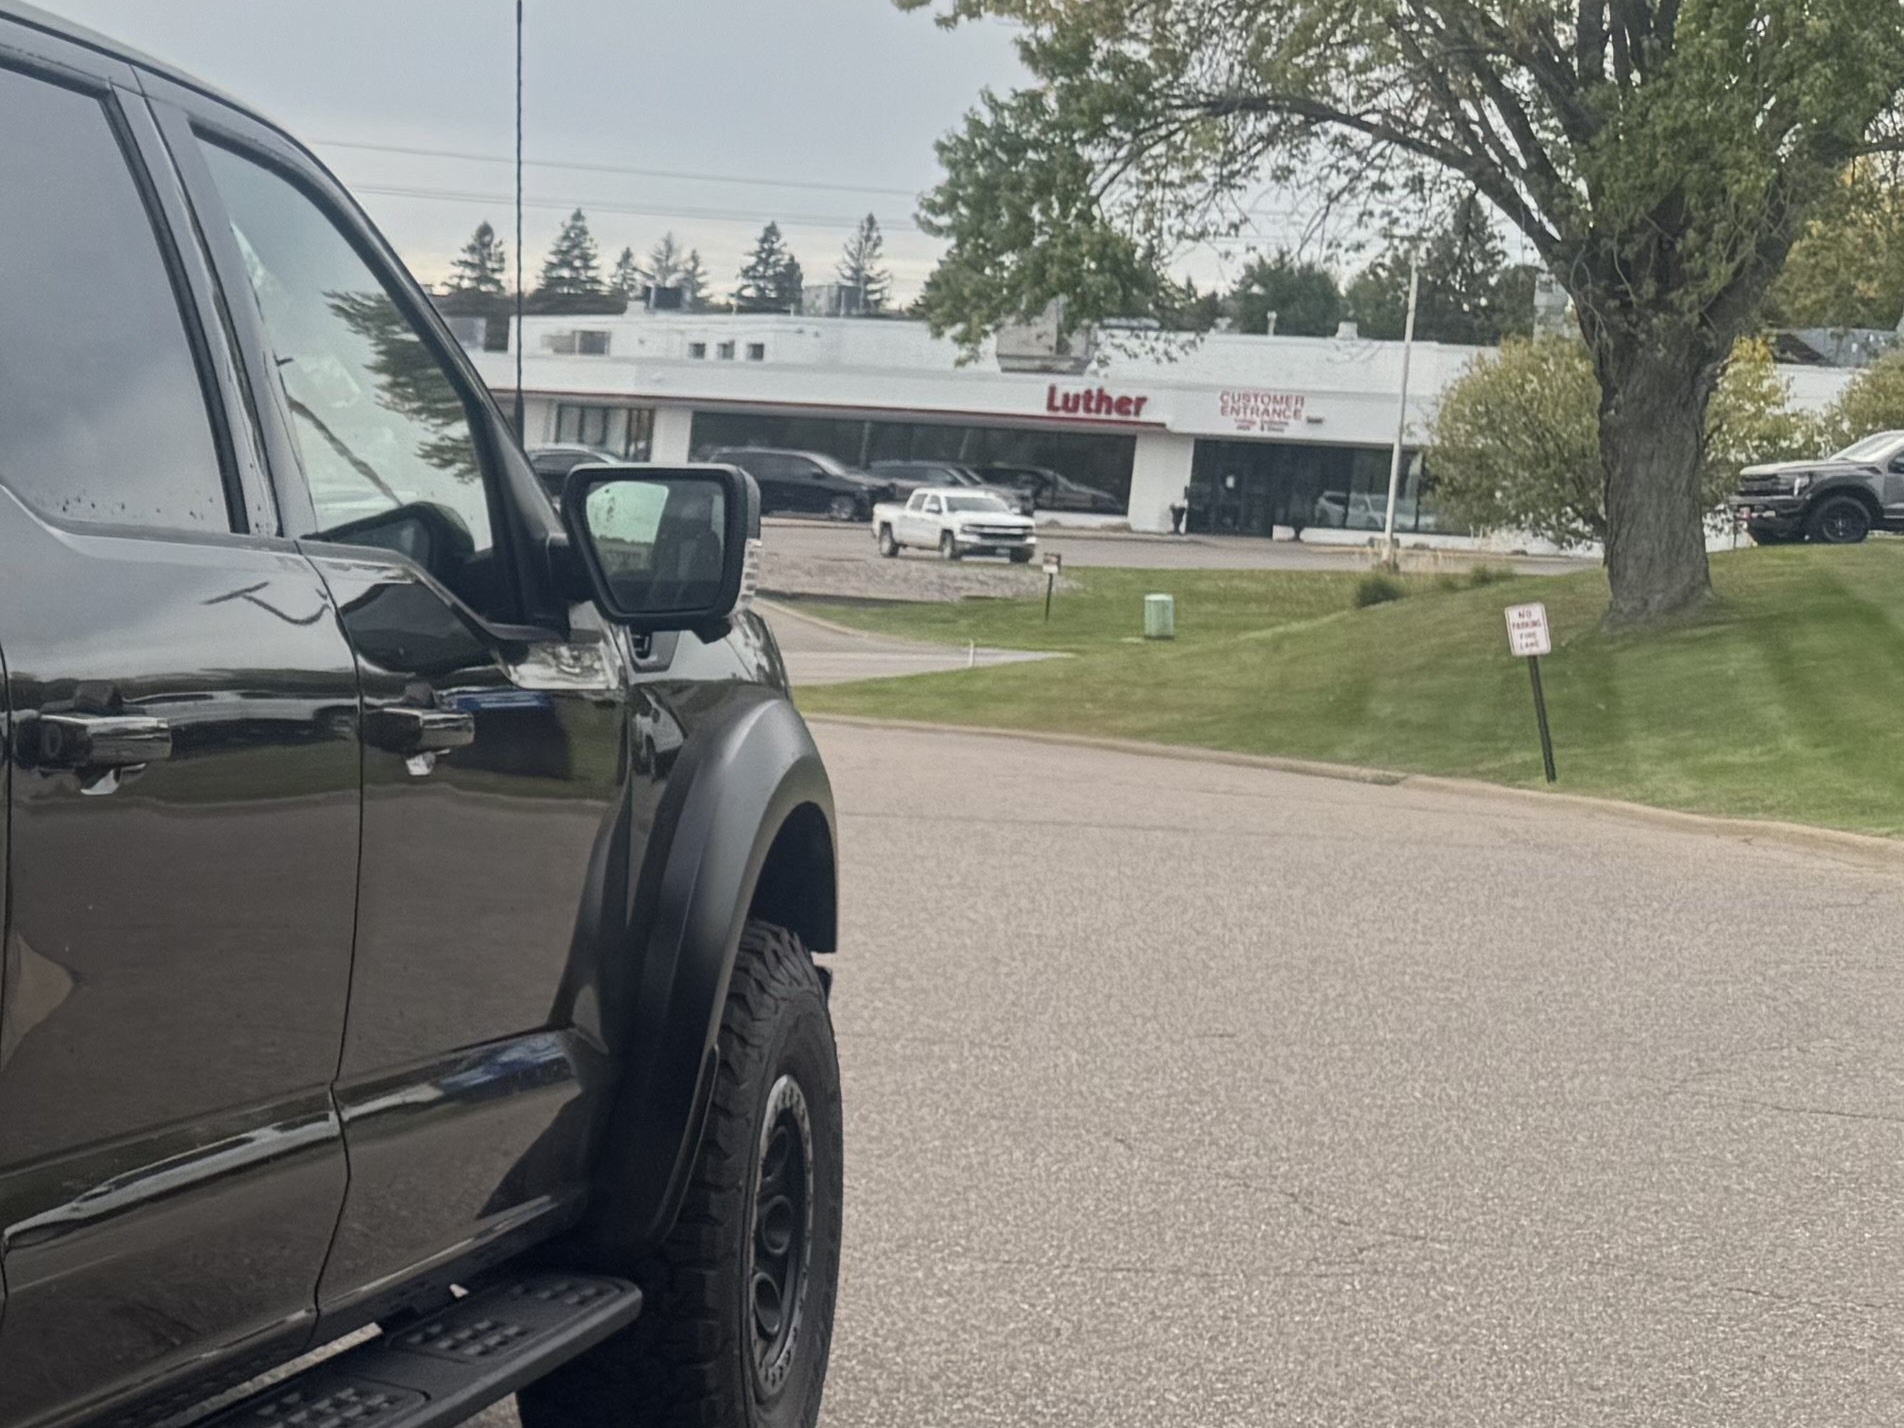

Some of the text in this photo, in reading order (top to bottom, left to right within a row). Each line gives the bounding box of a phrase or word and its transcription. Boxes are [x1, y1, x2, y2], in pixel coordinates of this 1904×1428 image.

[1047, 383, 1149, 416] Luther
[1219, 391, 1306, 409] CUSTOMER
[1220, 404, 1303, 420] ENTRANCE
[1518, 610, 1532, 619] NO
[1512, 620, 1542, 630] PARKING
[1520, 631, 1537, 640] FIRE
[1520, 641, 1540, 651] LANE
